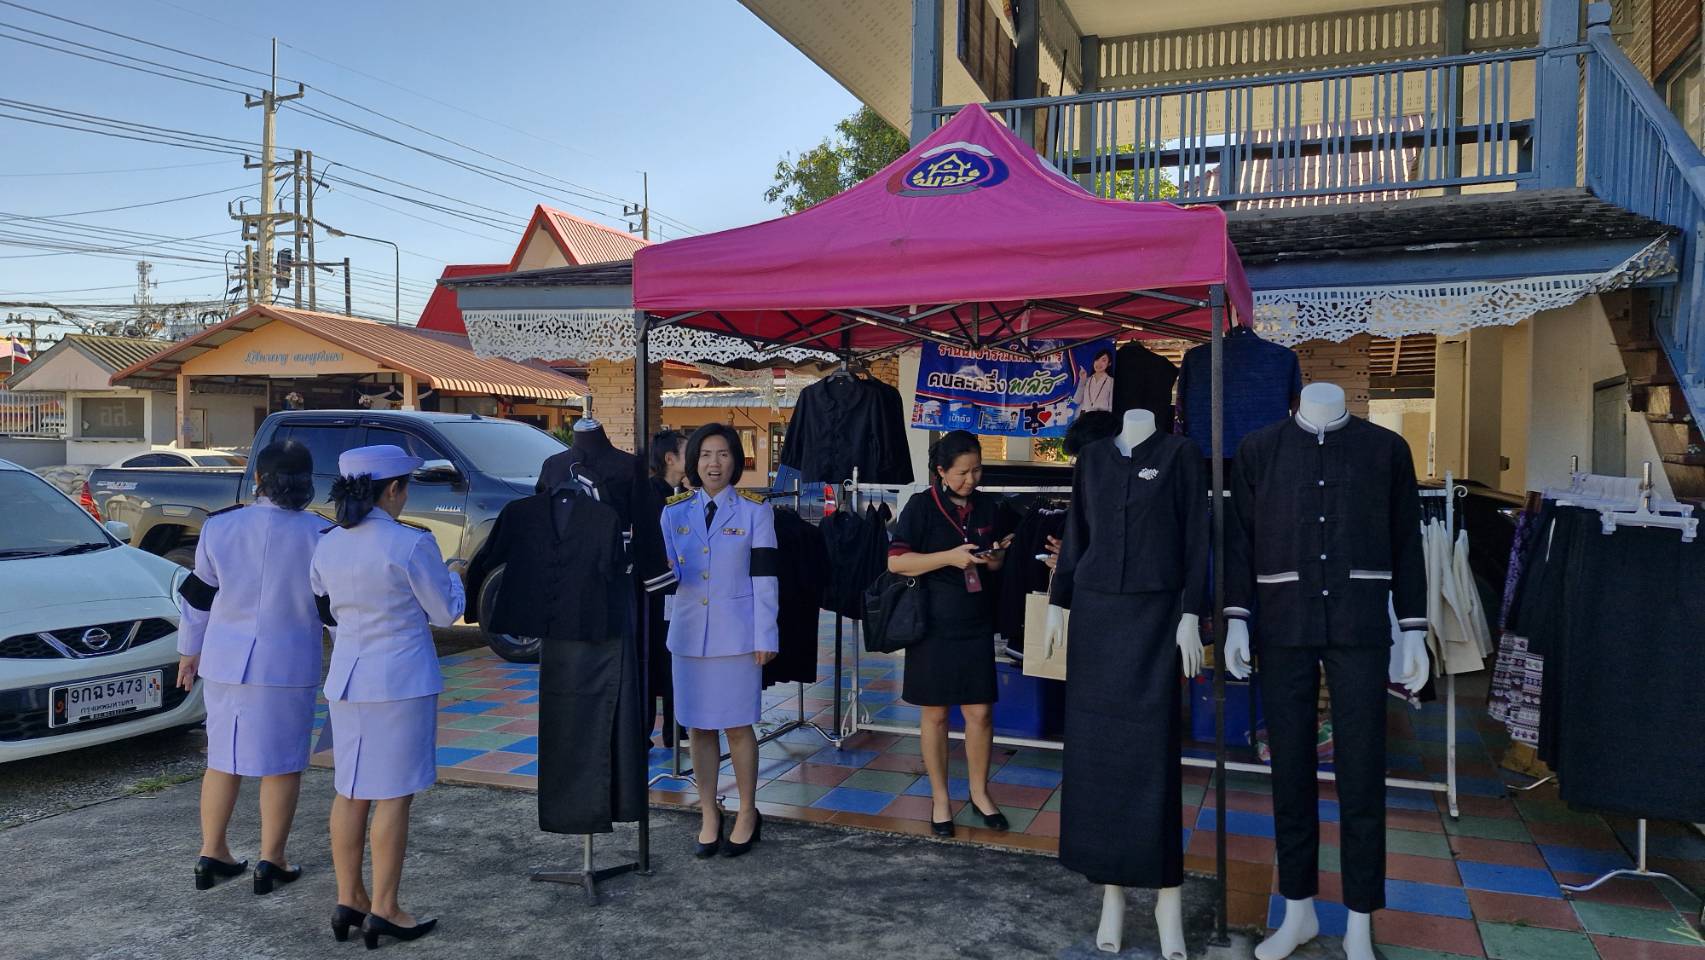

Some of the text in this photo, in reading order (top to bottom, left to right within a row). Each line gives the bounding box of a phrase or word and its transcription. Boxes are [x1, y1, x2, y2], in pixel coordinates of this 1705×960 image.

[927, 369, 1067, 395] คนละครึ่ง พลัส
[107, 679, 143, 697] 5473
